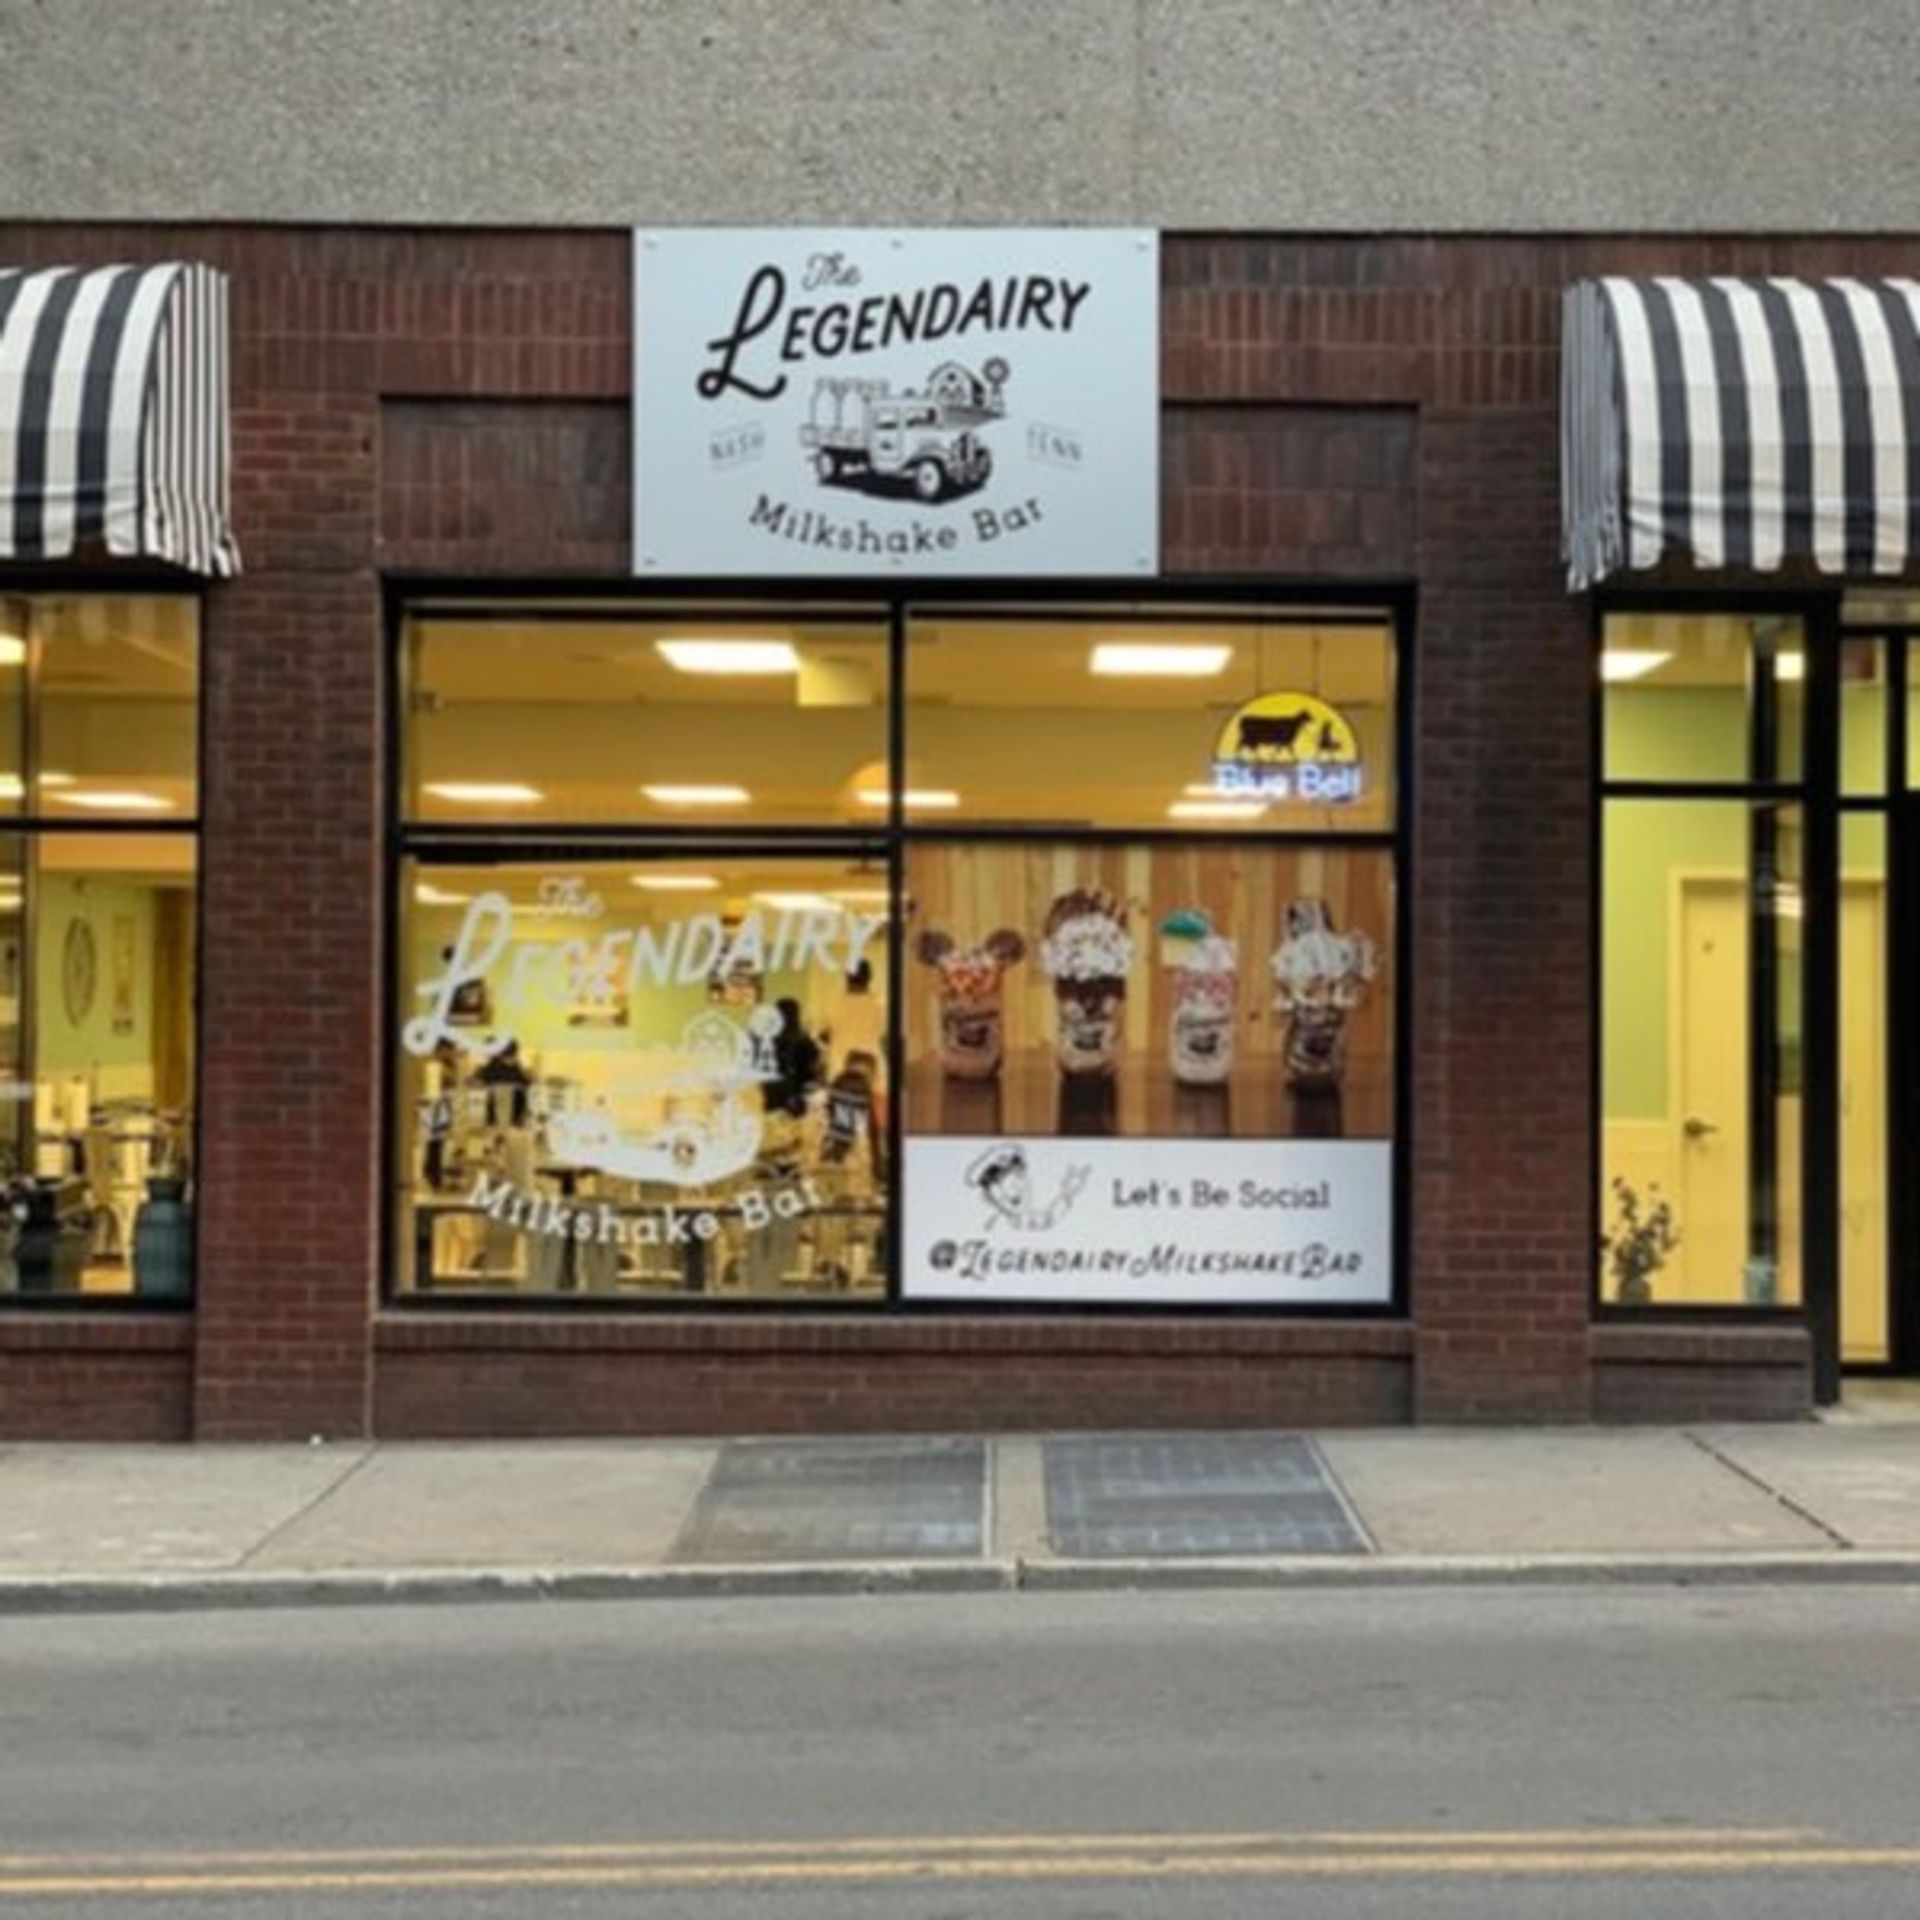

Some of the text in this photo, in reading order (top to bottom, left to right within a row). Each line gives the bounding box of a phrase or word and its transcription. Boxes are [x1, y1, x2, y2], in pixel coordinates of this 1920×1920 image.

[802, 252, 862, 292] The
[696, 264, 1091, 401] LEGENDAIRY
[747, 494, 1044, 554] Milkshake Bar
[1213, 763, 1362, 803] Blue Bell
[402, 890, 884, 1056] LEGENDAIRY
[466, 1172, 826, 1246] Milkshake Bar
[1112, 1178, 1332, 1211] Let's Be Social
